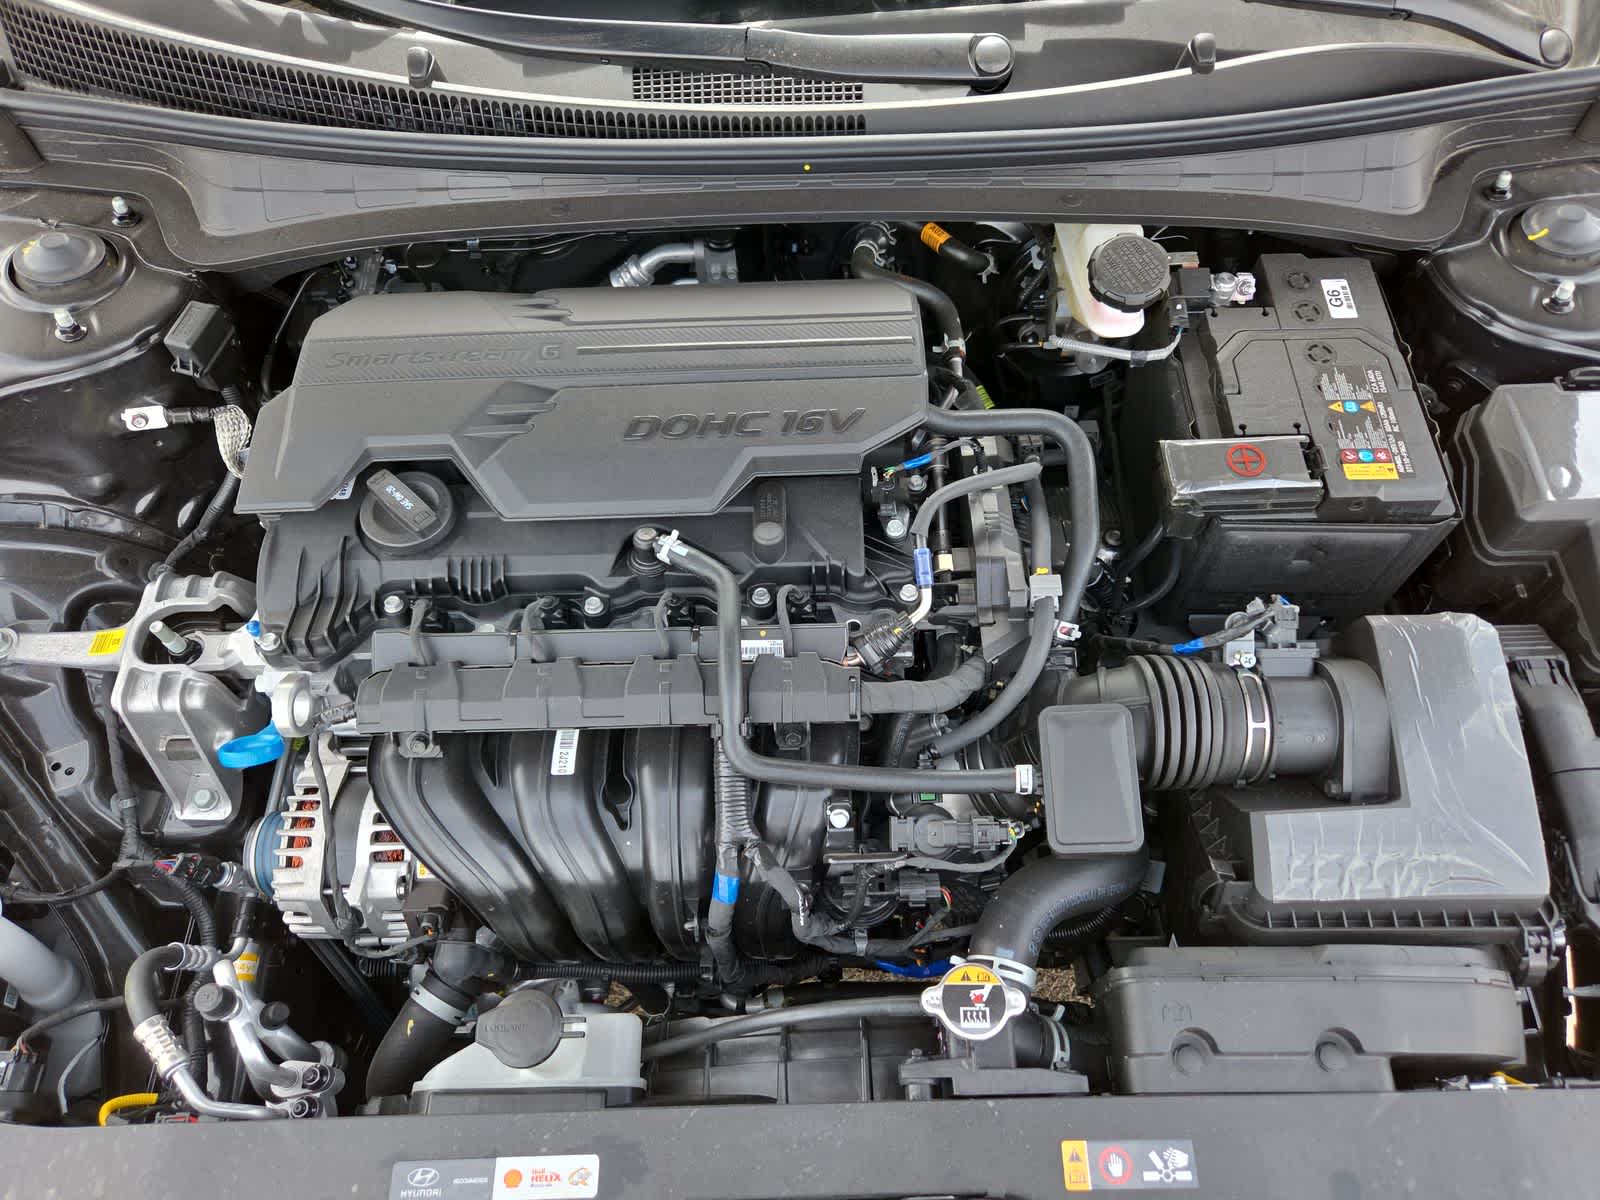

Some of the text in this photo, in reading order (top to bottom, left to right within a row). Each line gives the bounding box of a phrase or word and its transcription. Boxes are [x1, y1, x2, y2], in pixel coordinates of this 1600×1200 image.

[1327, 289, 1343, 307] G6
[624, 408, 867, 440] DOHC 16V
[531, 1174, 561, 1183] HELIX
[400, 1188, 442, 1198] HYUNDAI
